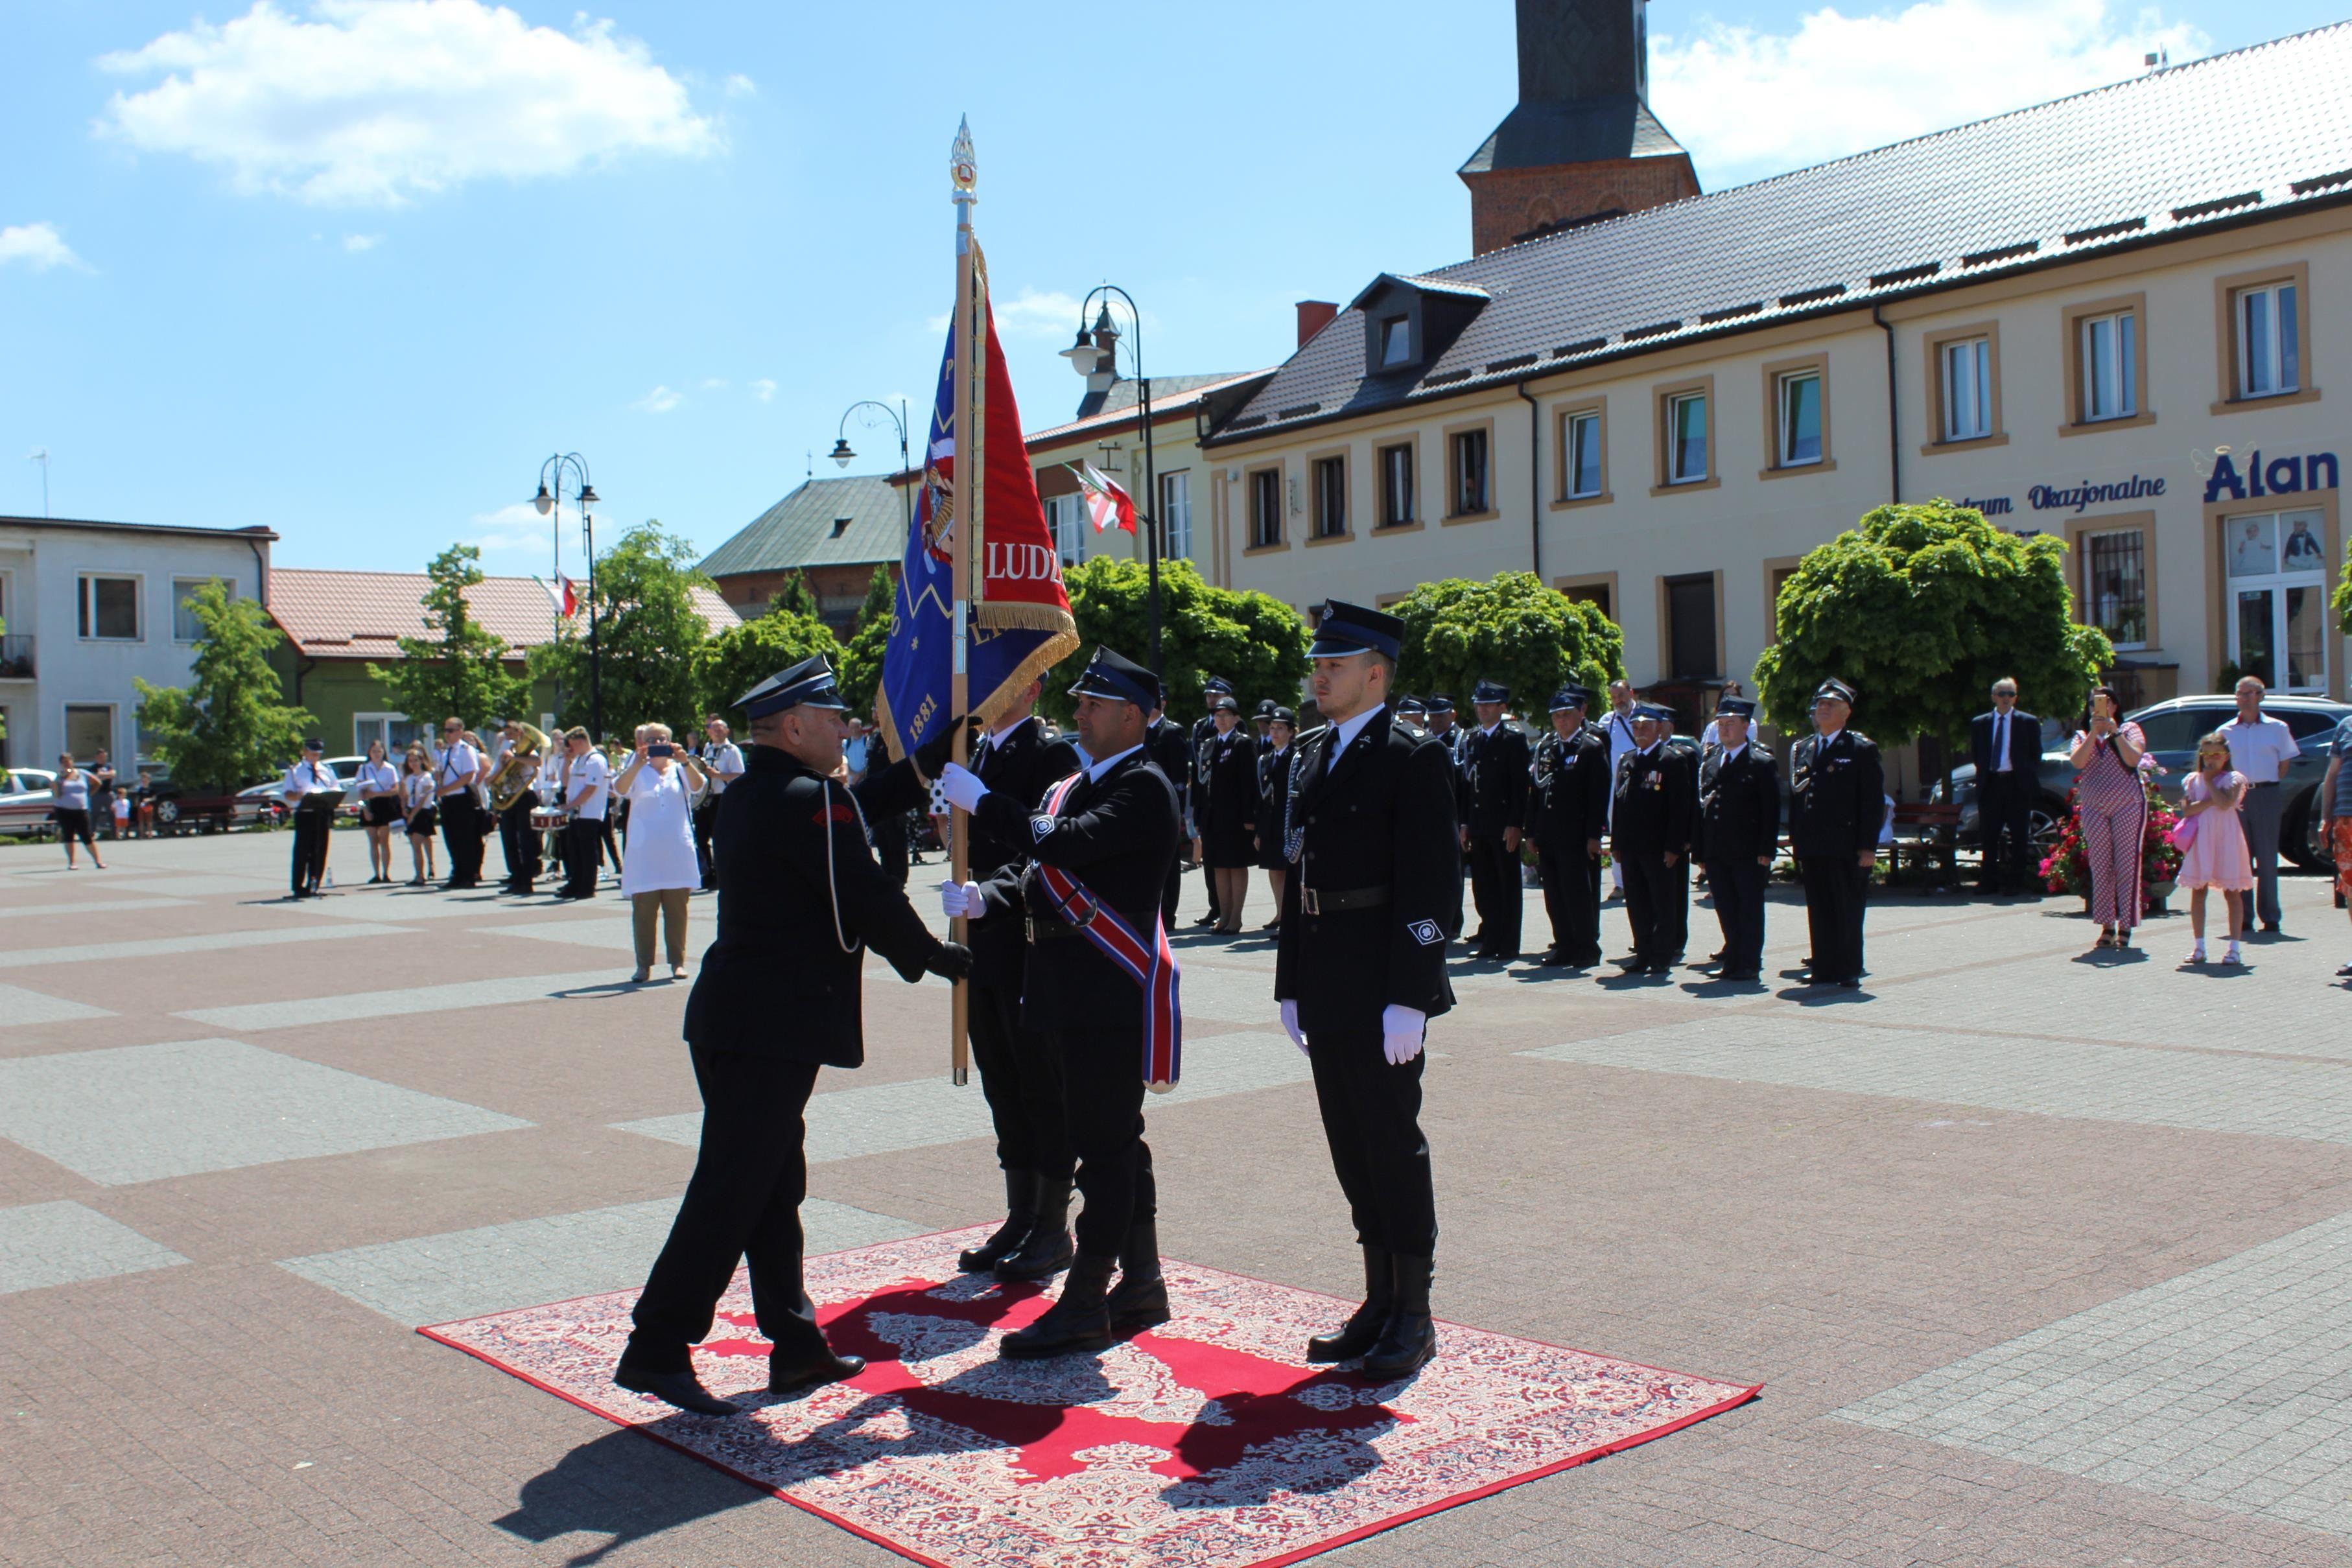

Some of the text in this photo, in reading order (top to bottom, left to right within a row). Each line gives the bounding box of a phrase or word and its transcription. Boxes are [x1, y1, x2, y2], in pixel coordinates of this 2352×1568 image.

[2028, 474, 2167, 513] Okazjonalne
[2203, 450, 2339, 503] Alan
[986, 542, 1067, 592] LUDZ
[910, 693, 938, 744] 1881
